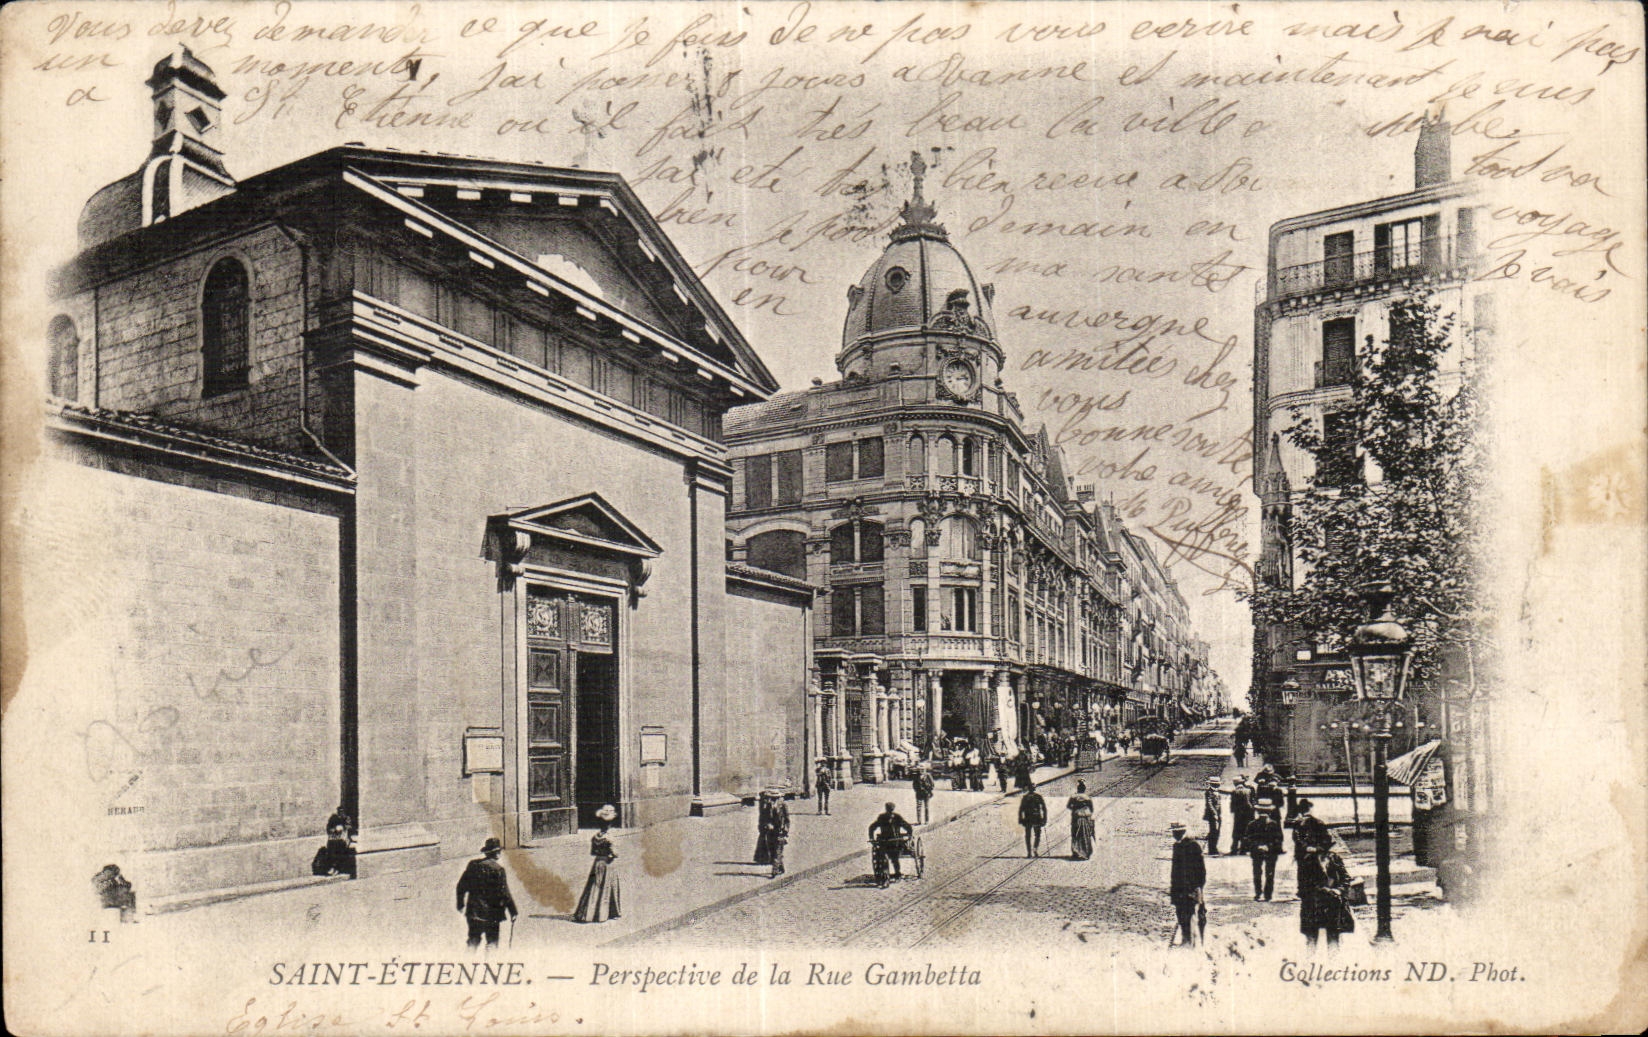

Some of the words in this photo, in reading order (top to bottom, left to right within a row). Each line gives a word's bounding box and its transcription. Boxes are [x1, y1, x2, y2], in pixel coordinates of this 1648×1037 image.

[461, 17, 498, 38] ce
[498, 18, 608, 58] que
[769, 3, 816, 45] de
[861, 13, 972, 65] pas
[997, 19, 1106, 43] vous
[1283, 10, 1404, 42] mais
[1118, 50, 1178, 87] et
[905, 90, 1027, 138] beau
[1046, 96, 1105, 139] la
[942, 147, 1013, 193] bien
[965, 194, 1151, 238] demain
[1186, 219, 1249, 241] en
[694, 248, 826, 285] pour
[732, 287, 803, 316] en
[1036, 388, 1131, 414] vous
